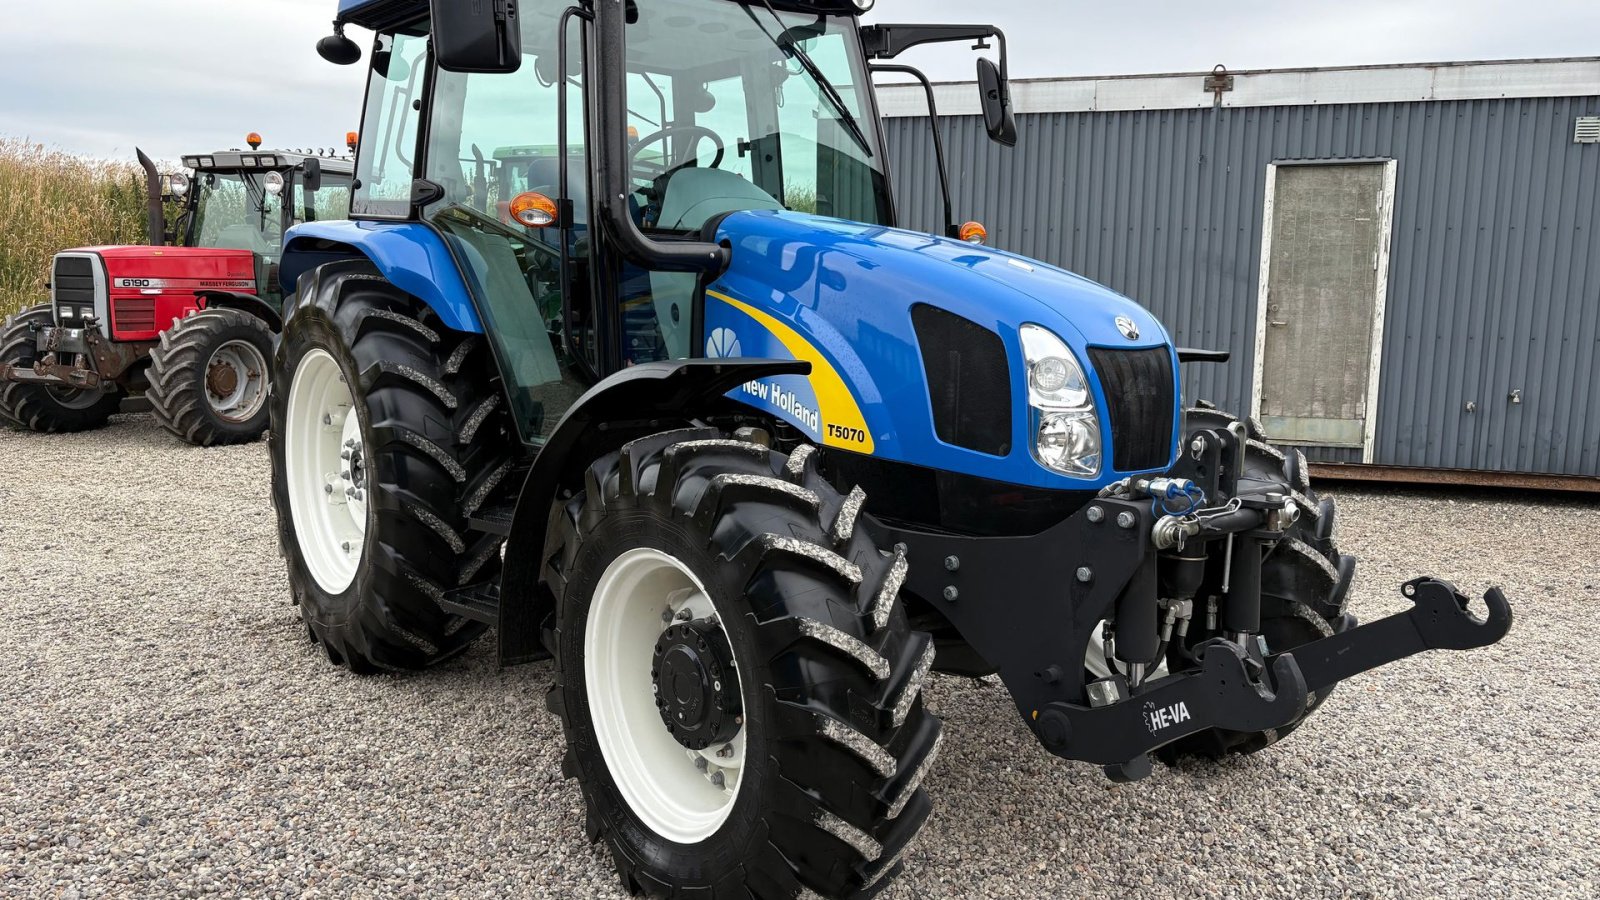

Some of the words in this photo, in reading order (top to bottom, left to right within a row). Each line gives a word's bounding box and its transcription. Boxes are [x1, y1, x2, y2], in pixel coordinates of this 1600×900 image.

[123, 279, 150, 287] 6190
[771, 383, 818, 433] Holland
[827, 423, 865, 443] T5070
[1150, 701, 1191, 731] HE-VA
